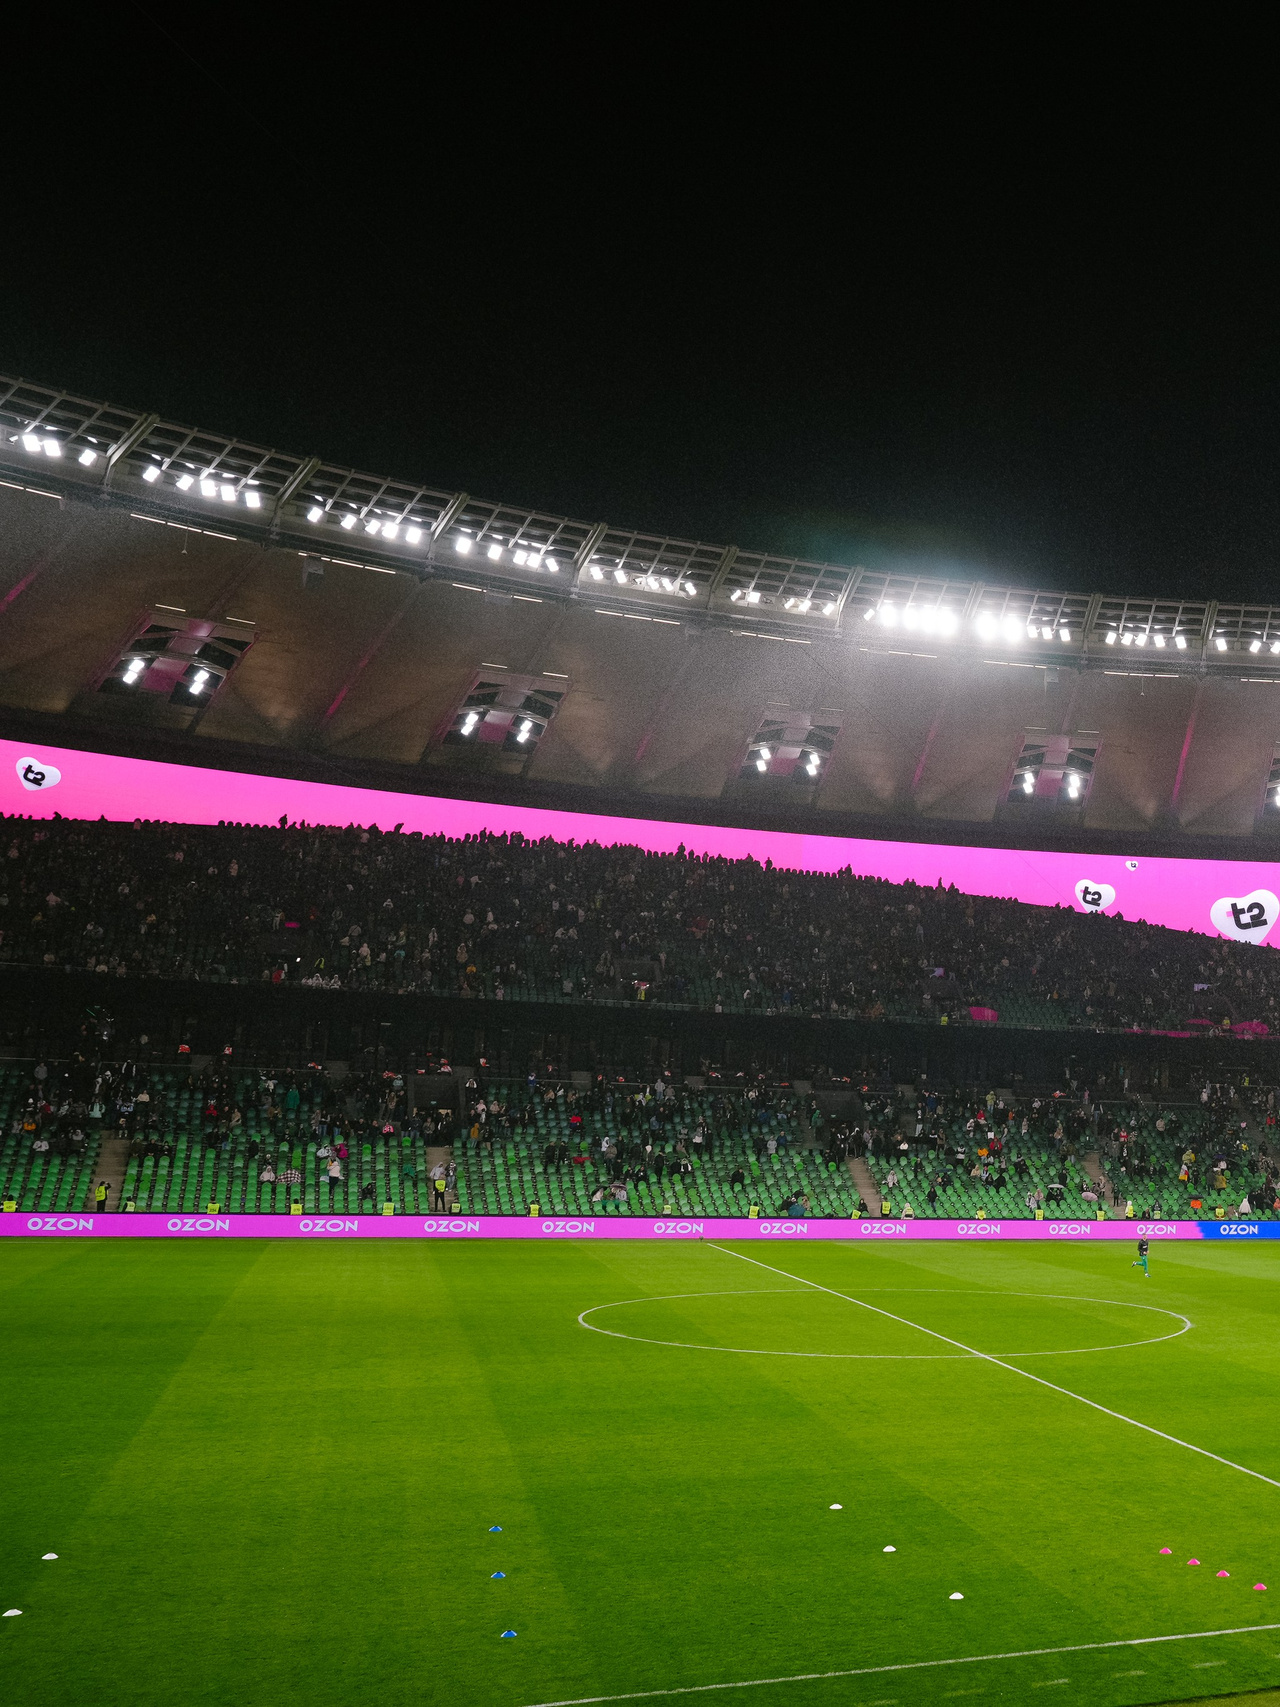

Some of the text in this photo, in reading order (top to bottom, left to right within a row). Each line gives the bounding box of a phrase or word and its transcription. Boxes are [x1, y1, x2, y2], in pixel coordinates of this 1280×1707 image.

[22, 764, 46, 787] t2
[1080, 886, 1103, 907] t2
[1226, 901, 1268, 930] t2
[28, 1218, 94, 1231] OZON
[167, 1219, 230, 1232] OZON
[299, 1220, 359, 1232] OZON
[424, 1220, 480, 1233] OZON
[541, 1221, 595, 1233] OZON
[653, 1222, 704, 1234] OZON
[760, 1223, 809, 1234] OZON
[861, 1223, 907, 1234] OZON
[957, 1224, 1001, 1235] OZON
[1048, 1224, 1091, 1235] OZON
[1137, 1224, 1177, 1235] OZON
[1219, 1224, 1259, 1235] OZON
